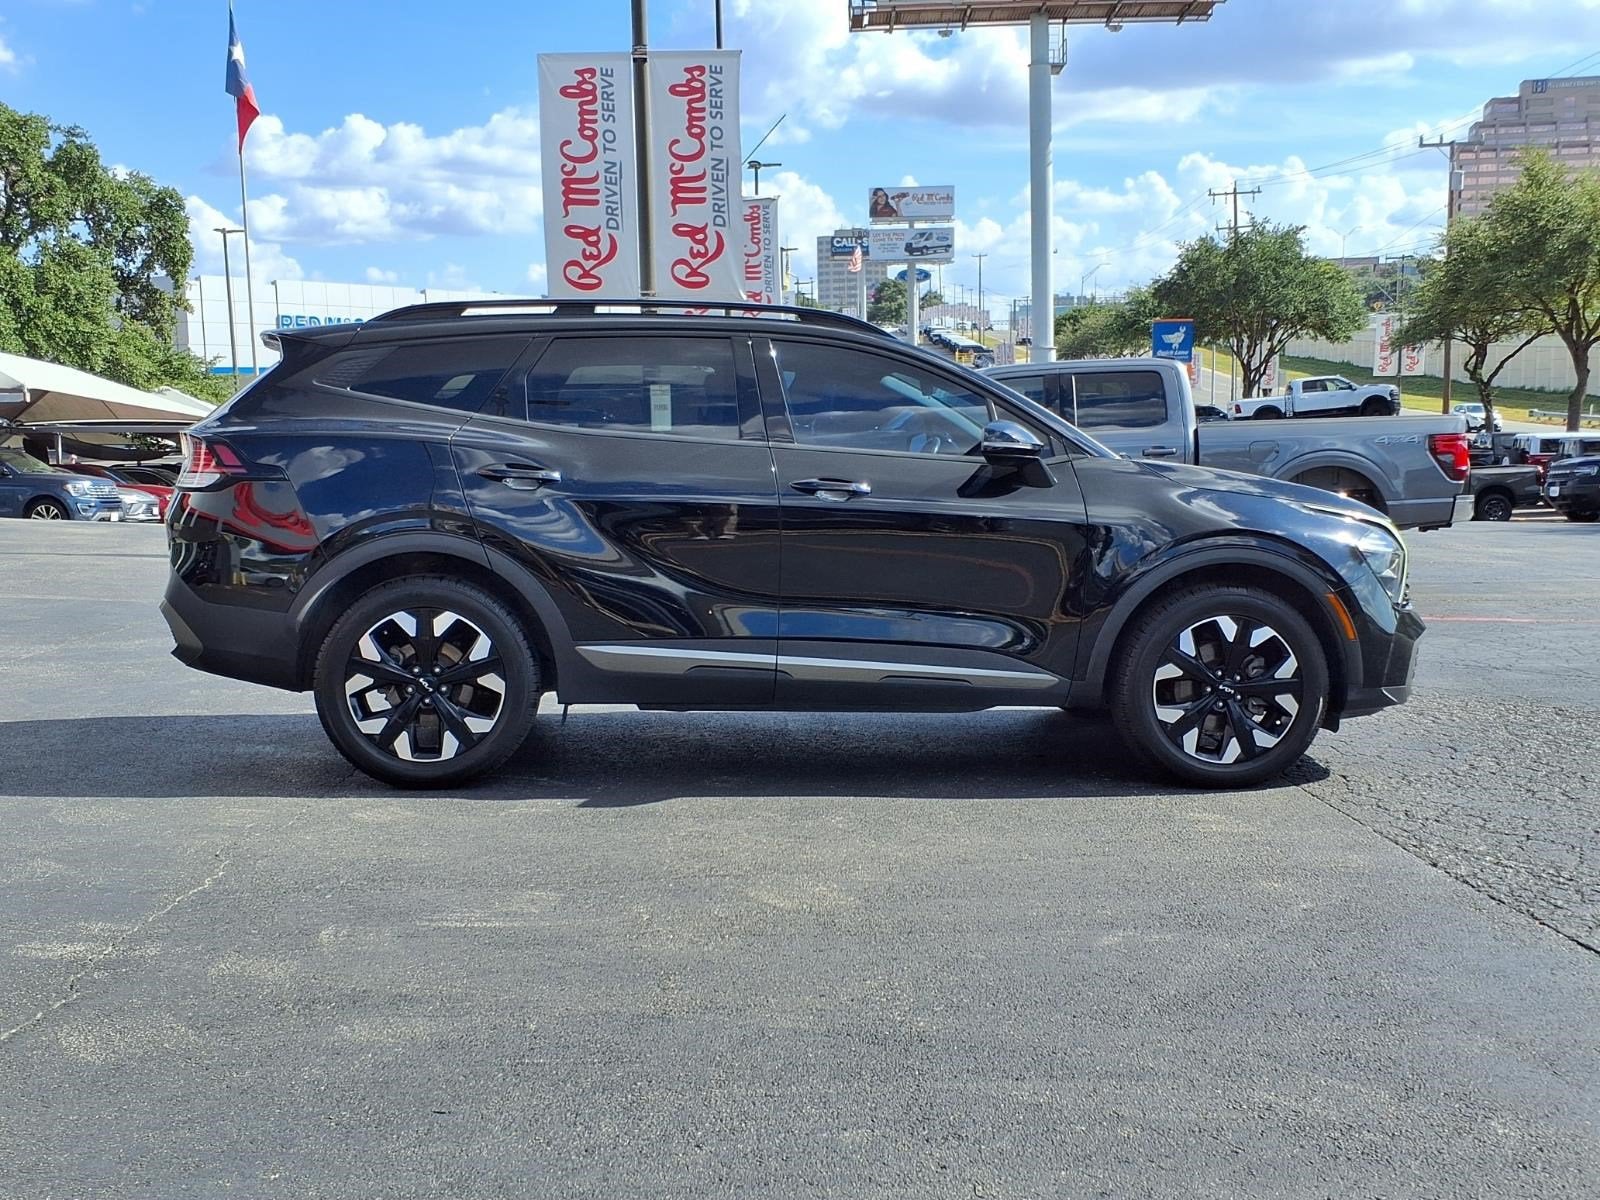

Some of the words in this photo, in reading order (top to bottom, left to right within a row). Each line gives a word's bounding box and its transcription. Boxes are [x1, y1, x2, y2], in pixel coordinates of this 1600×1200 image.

[600, 67, 616, 123] SERVE
[709, 64, 723, 120] SERVE
[559, 67, 601, 218] McCombs
[603, 128, 617, 154] TO
[668, 64, 708, 217] McCombs
[710, 126, 725, 152] TO
[603, 160, 621, 231] DRIVEN
[710, 158, 727, 228] DRIVEN
[762, 204, 771, 237] SERVE
[563, 224, 618, 291] Red
[670, 223, 725, 290] Red
[763, 237, 771, 254] TO
[764, 255, 773, 293] DRIVEN
[281, 315, 321, 328] RED
